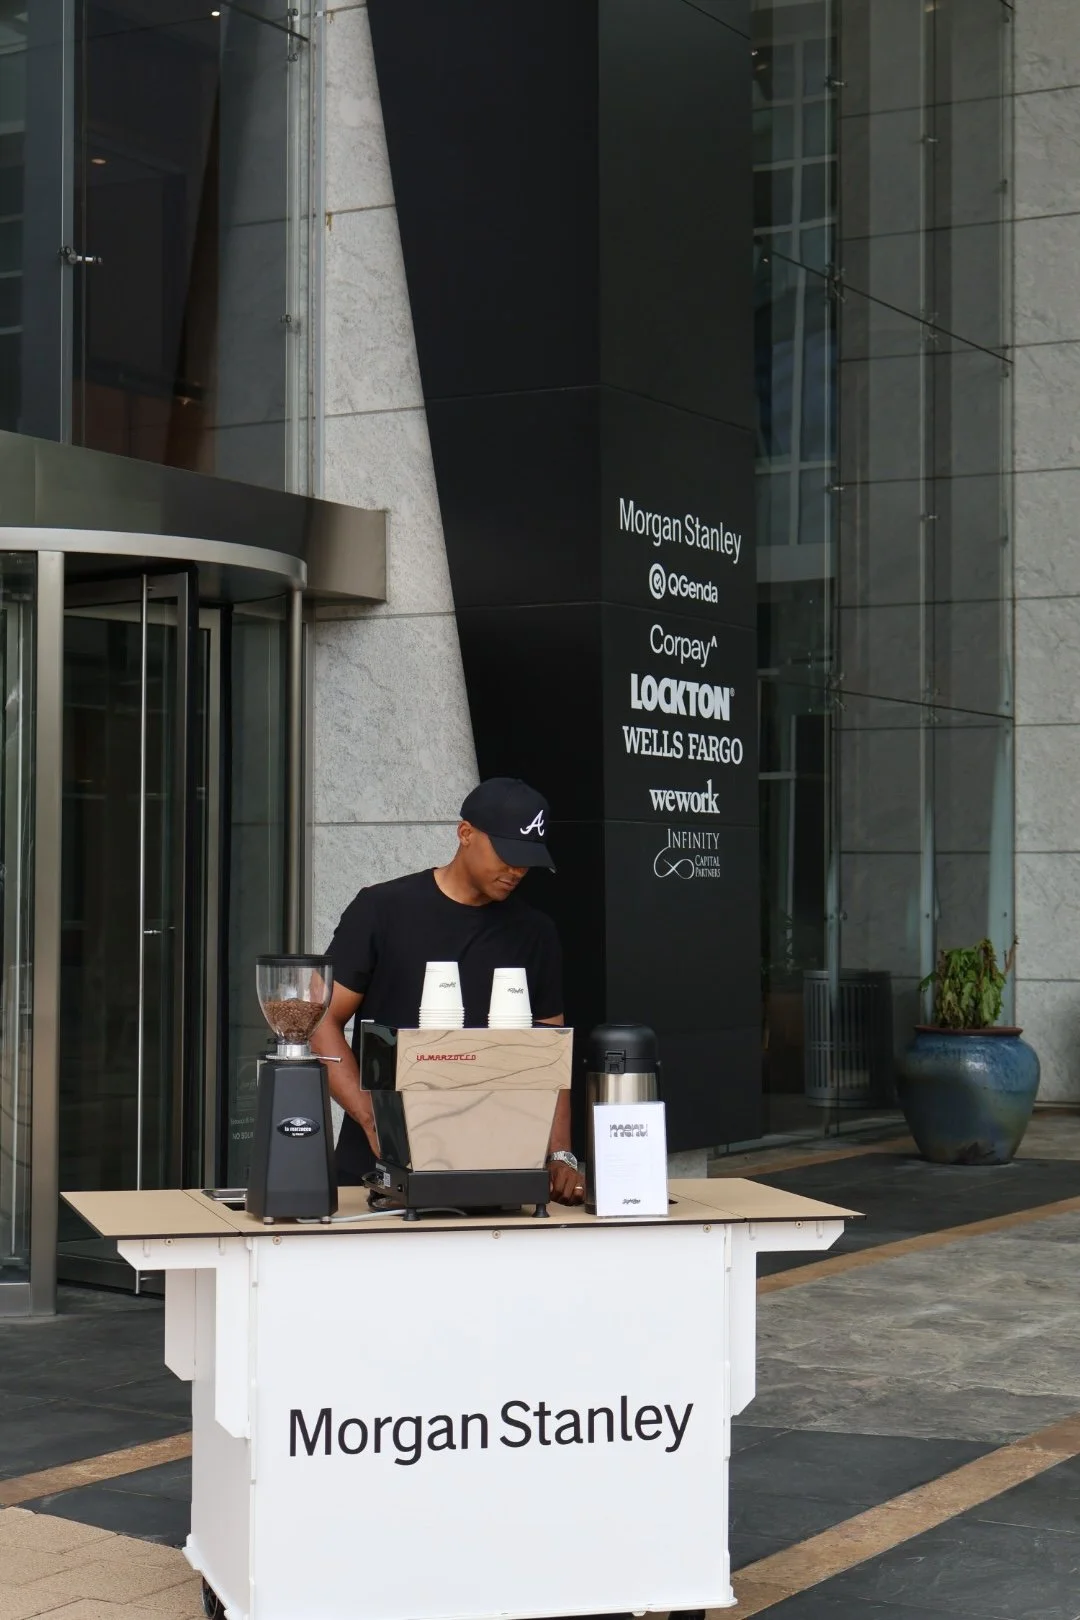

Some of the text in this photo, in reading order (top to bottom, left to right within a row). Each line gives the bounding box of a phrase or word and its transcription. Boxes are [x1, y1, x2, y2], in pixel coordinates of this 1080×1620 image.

[619, 497, 742, 564] Morgan Stanley
[668, 572, 718, 603] QGenda
[622, 725, 743, 765] WELLS FARGO
[649, 779, 720, 814] wework
[667, 828, 720, 850] INFINITY
[695, 854, 720, 867] CAPITAL
[695, 868, 720, 878] PARTNERS
[289, 1395, 694, 1466] Morgan Stanley
